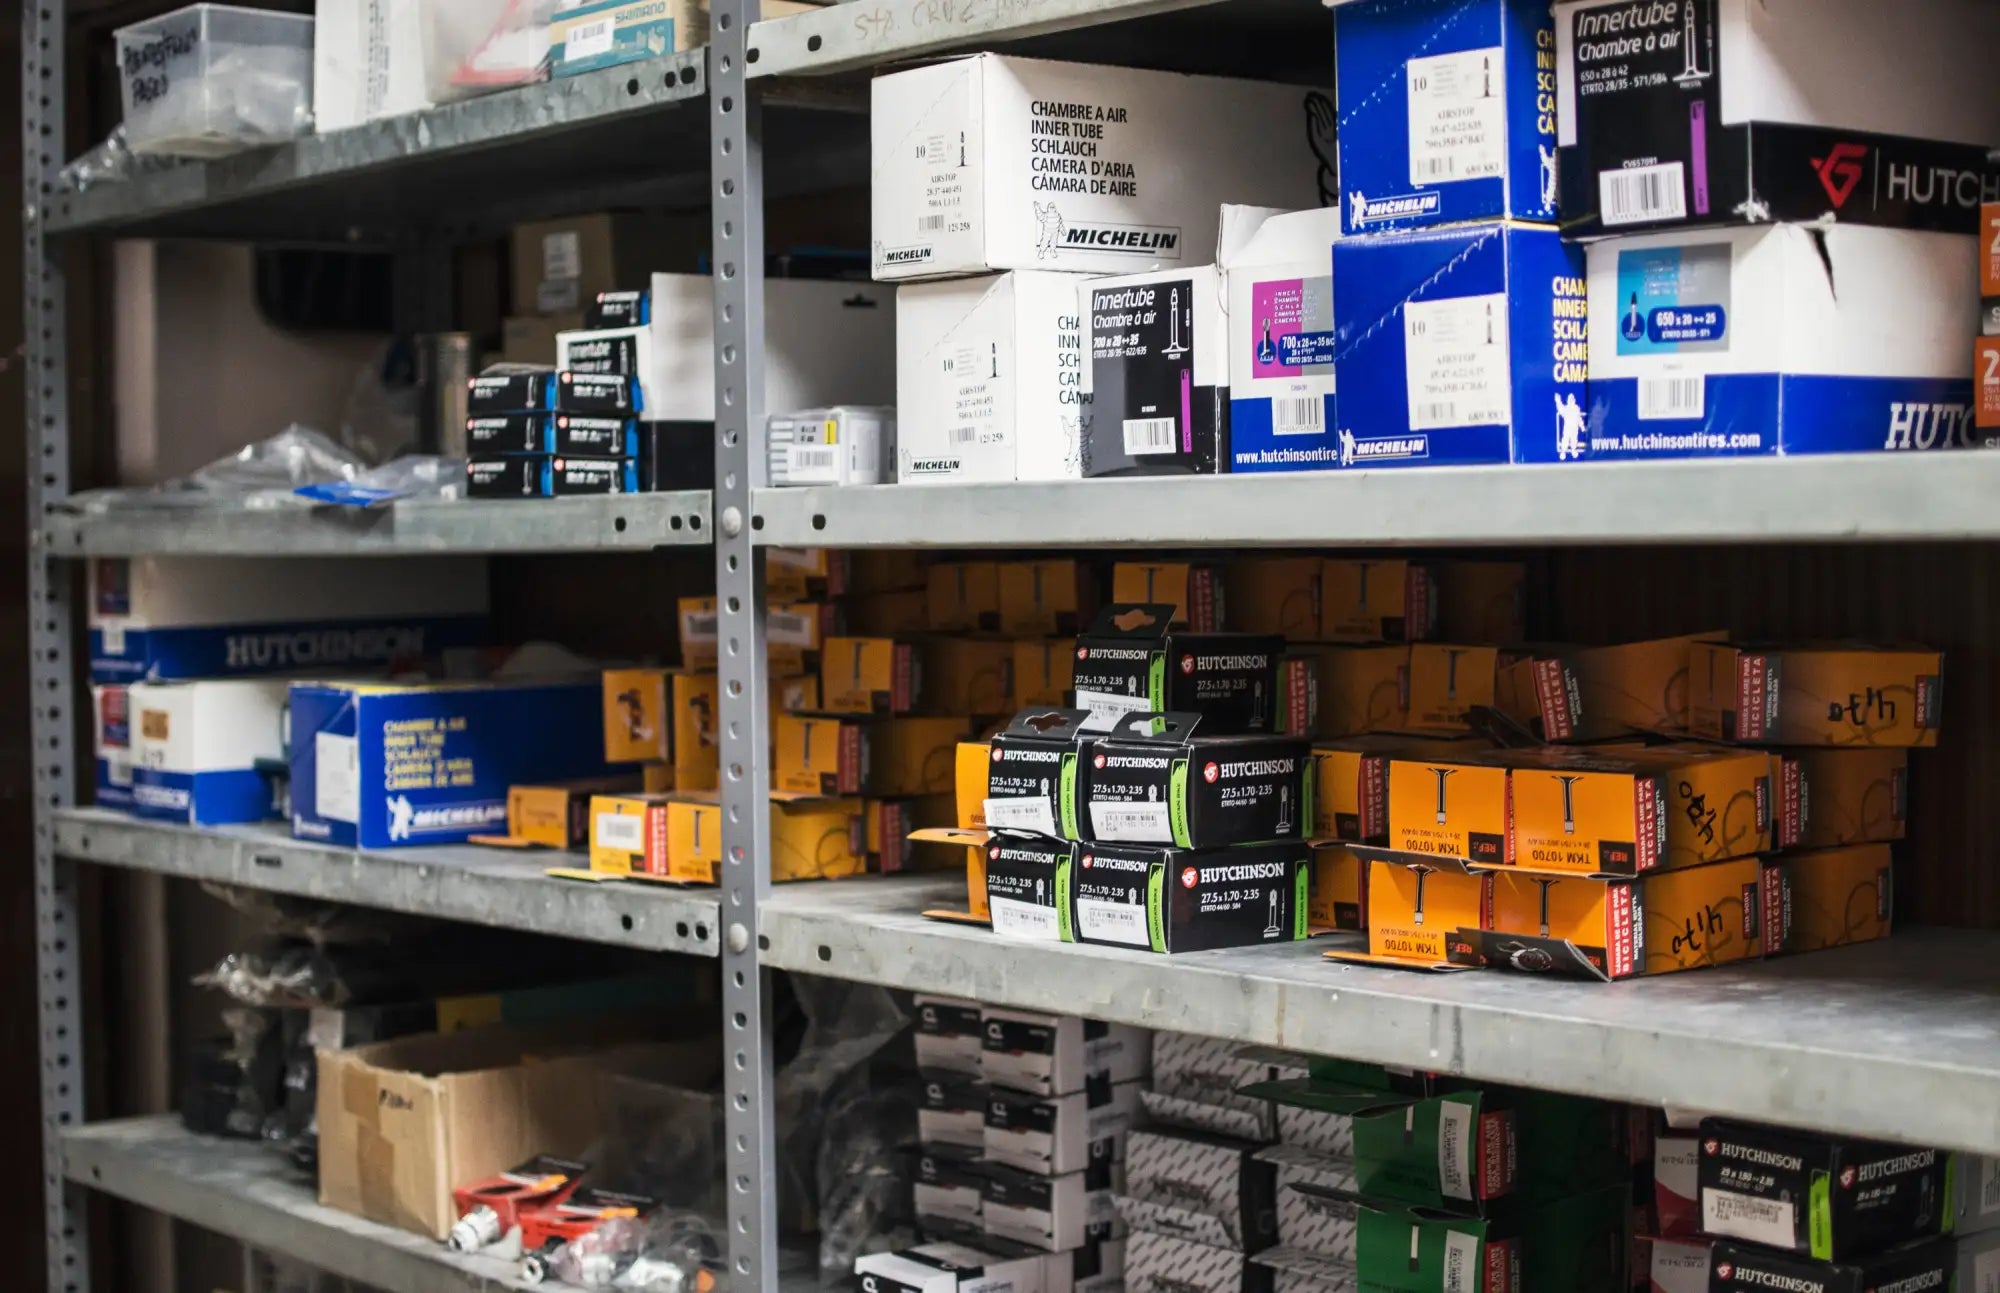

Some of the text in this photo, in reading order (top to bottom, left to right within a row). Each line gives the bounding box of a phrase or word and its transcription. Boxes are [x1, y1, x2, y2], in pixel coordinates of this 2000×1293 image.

[614, 2, 666, 25] SHIMANO
[1577, 1, 1677, 38] Innertube
[1578, 30, 1680, 62] Chambre à air
[1580, 64, 1629, 82] 650 28 42
[1413, 76, 1427, 92] 10
[1031, 100, 1127, 123] CHAMBRE A AIR
[1031, 119, 1103, 139] INNER TUBE
[915, 145, 926, 158] 10
[1031, 138, 1097, 157] SCHLAUCH
[1031, 157, 1135, 178] CAMERA D'ARIA
[1031, 173, 1137, 197] CÁMARA DE AIRE
[1367, 195, 1437, 216] MICHELIN
[1066, 227, 1177, 249] MICHELIN
[886, 248, 932, 262] MICHELIN
[1093, 288, 1155, 311] Innertube
[1094, 311, 1156, 329] Chambre à air
[1656, 311, 1674, 326] 650
[1705, 312, 1716, 324] 25
[1411, 321, 1426, 336] 10
[1282, 336, 1297, 349] 700
[1302, 338, 1309, 347] 28
[943, 359, 953, 372] 10
[1357, 439, 1425, 455] MICHELIN
[1591, 432, 1760, 452] www.hutchinsontires.com
[913, 461, 960, 470] MICHELIN
[1089, 648, 1148, 660] HUTCHINSON
[1197, 655, 1268, 671] HUTCHINSON
[1075, 675, 1123, 685] 27.5 1.70 2.35
[1548, 660, 1568, 737] BICICLETA
[1752, 658, 1761, 737] BICICLETA
[1003, 750, 1061, 763] HUTCHINSON
[1106, 756, 1169, 769] HUTCHINSON
[1220, 758, 1295, 778] HUTCHINSON
[991, 776, 1037, 787] 27.5 1.70 2.35
[1093, 784, 1143, 794] 27.5 1.70 2.35
[1221, 784, 1273, 799] 27.5 1.70 2.35
[1374, 757, 1382, 834] BICICLETA
[1790, 760, 1798, 844] BICICLETA
[413, 806, 506, 826] MICHELIN
[1644, 780, 1654, 866] BICICLETA
[1000, 848, 1056, 864] HUTCHINSON
[1406, 839, 1462, 855] TKM 10700
[1478, 843, 1497, 853] REF
[1092, 857, 1149, 872] HUTCHINSON
[1532, 849, 1591, 865] TKM 10700
[988, 874, 1032, 888] 27.5 1.70 2.35
[1200, 862, 1285, 883] HUTCHINSON
[1079, 883, 1124, 897] 27.5 1.70 2.35
[1201, 888, 1260, 904] 27.5 1.70 2.35
[1613, 908, 1621, 928] AIRE
[1772, 868, 1781, 952] BICICLETA
[1620, 886, 1629, 972] BICICLETA
[1384, 939, 1439, 955] TKM 10700
[1455, 943, 1473, 953] REF
[1720, 1143, 1803, 1171] HUTCHINSON
[1858, 1148, 1935, 1182] HUTCHINSON
[1735, 1266, 1824, 1293] HUTCHINSON
